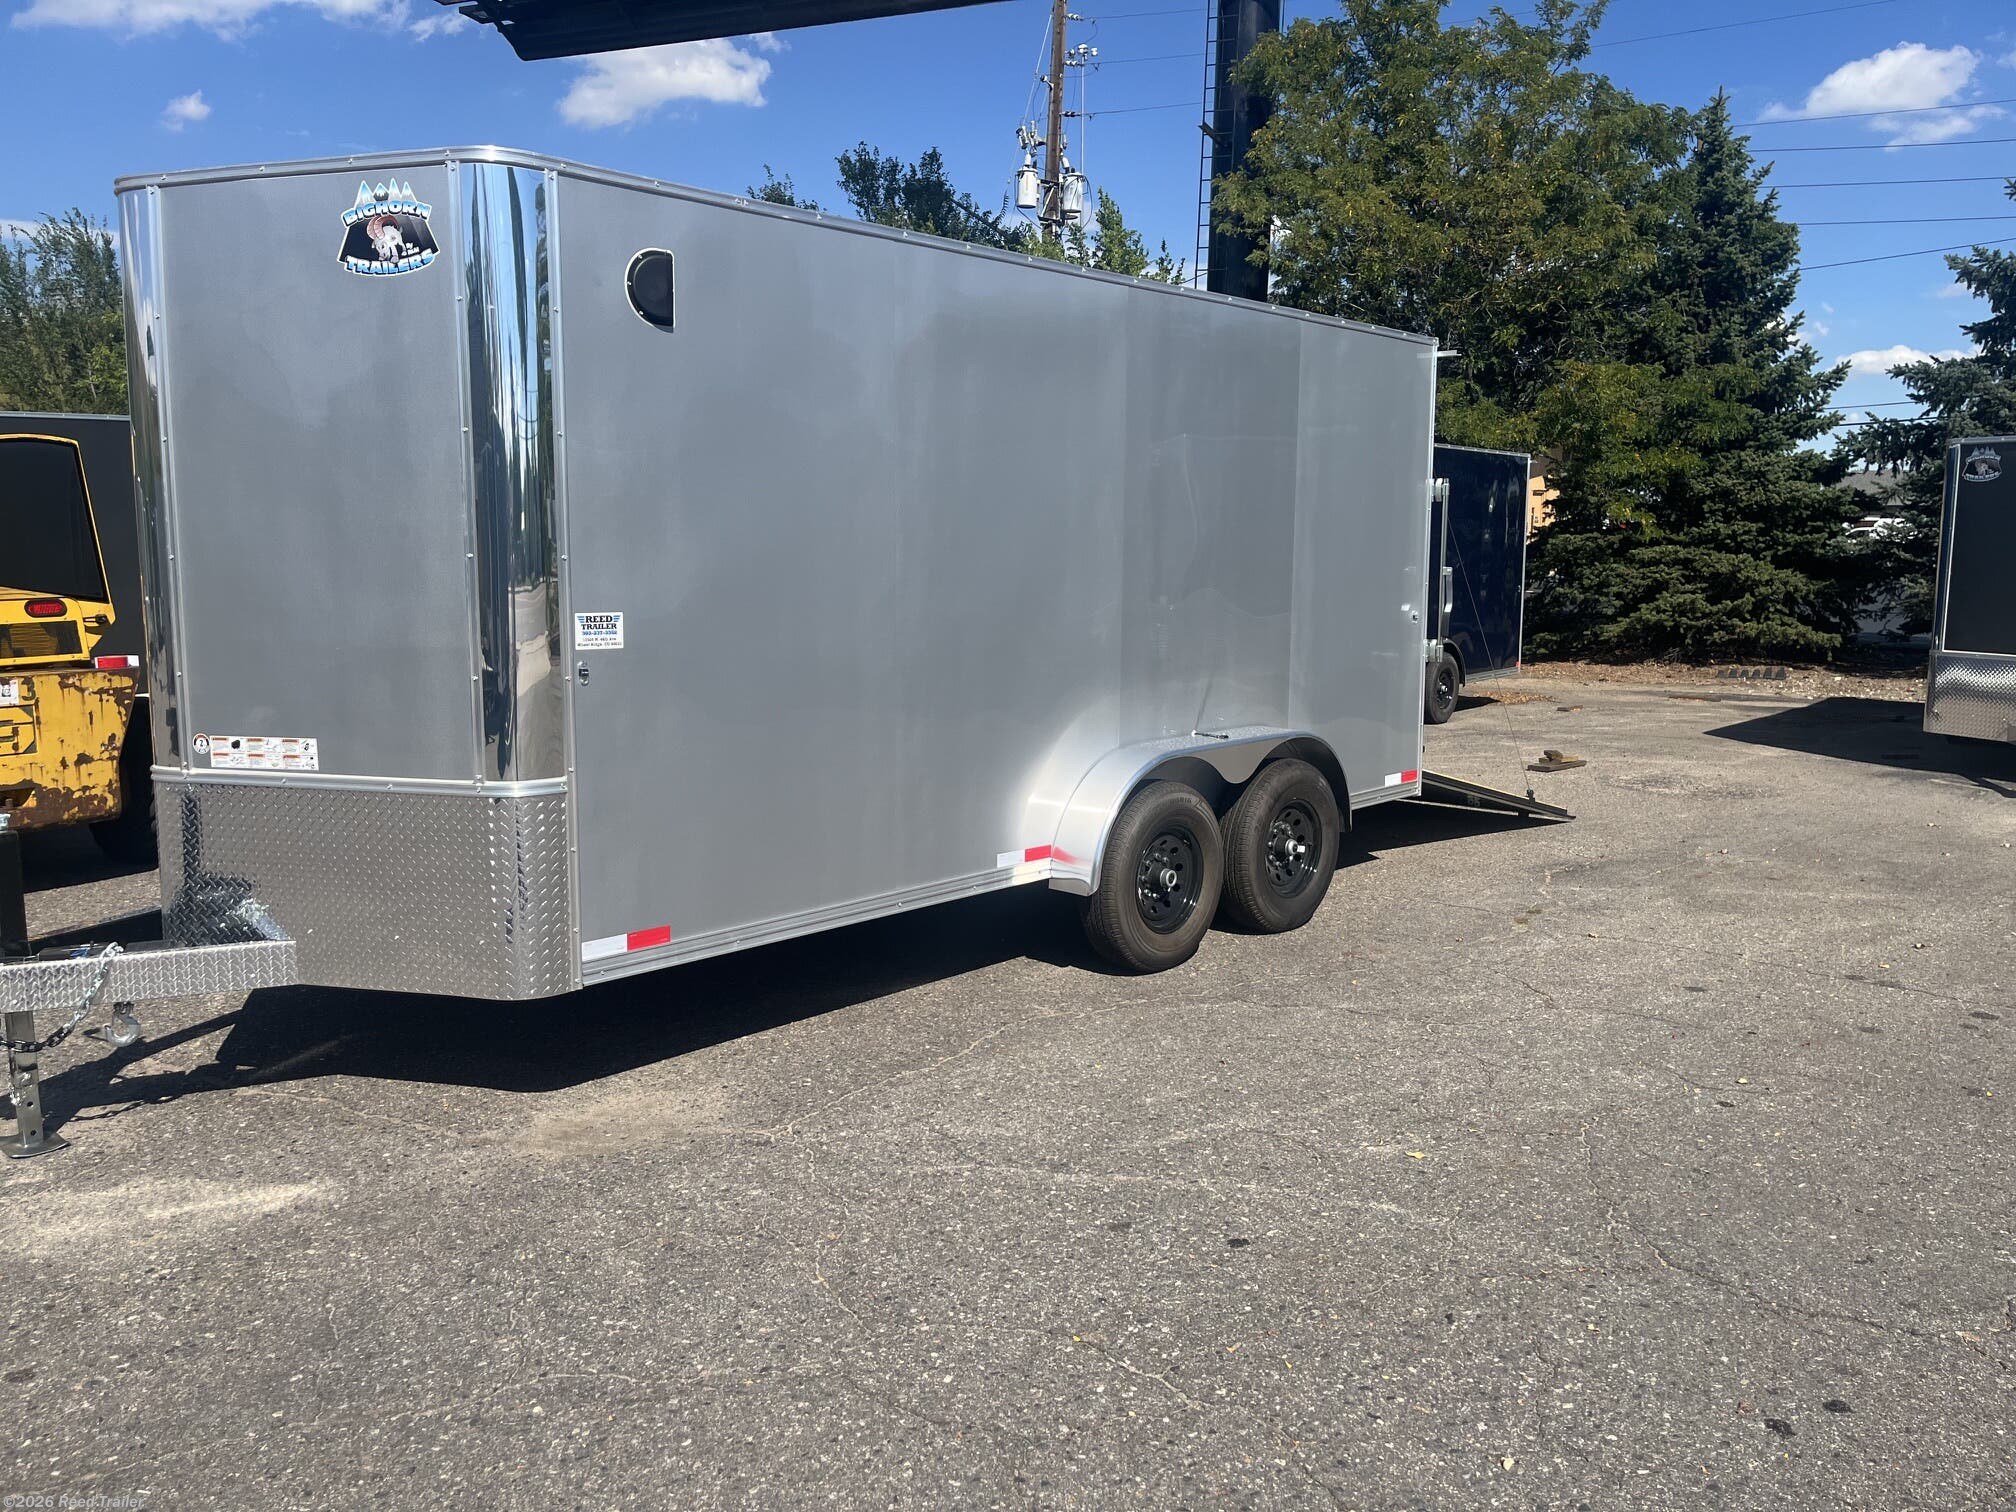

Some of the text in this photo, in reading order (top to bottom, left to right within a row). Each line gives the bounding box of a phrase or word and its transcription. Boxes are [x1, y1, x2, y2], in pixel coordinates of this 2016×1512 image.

[342, 200, 431, 227] BIGHORN
[345, 248, 435, 274] TRAILERS
[585, 615, 613, 623] REED
